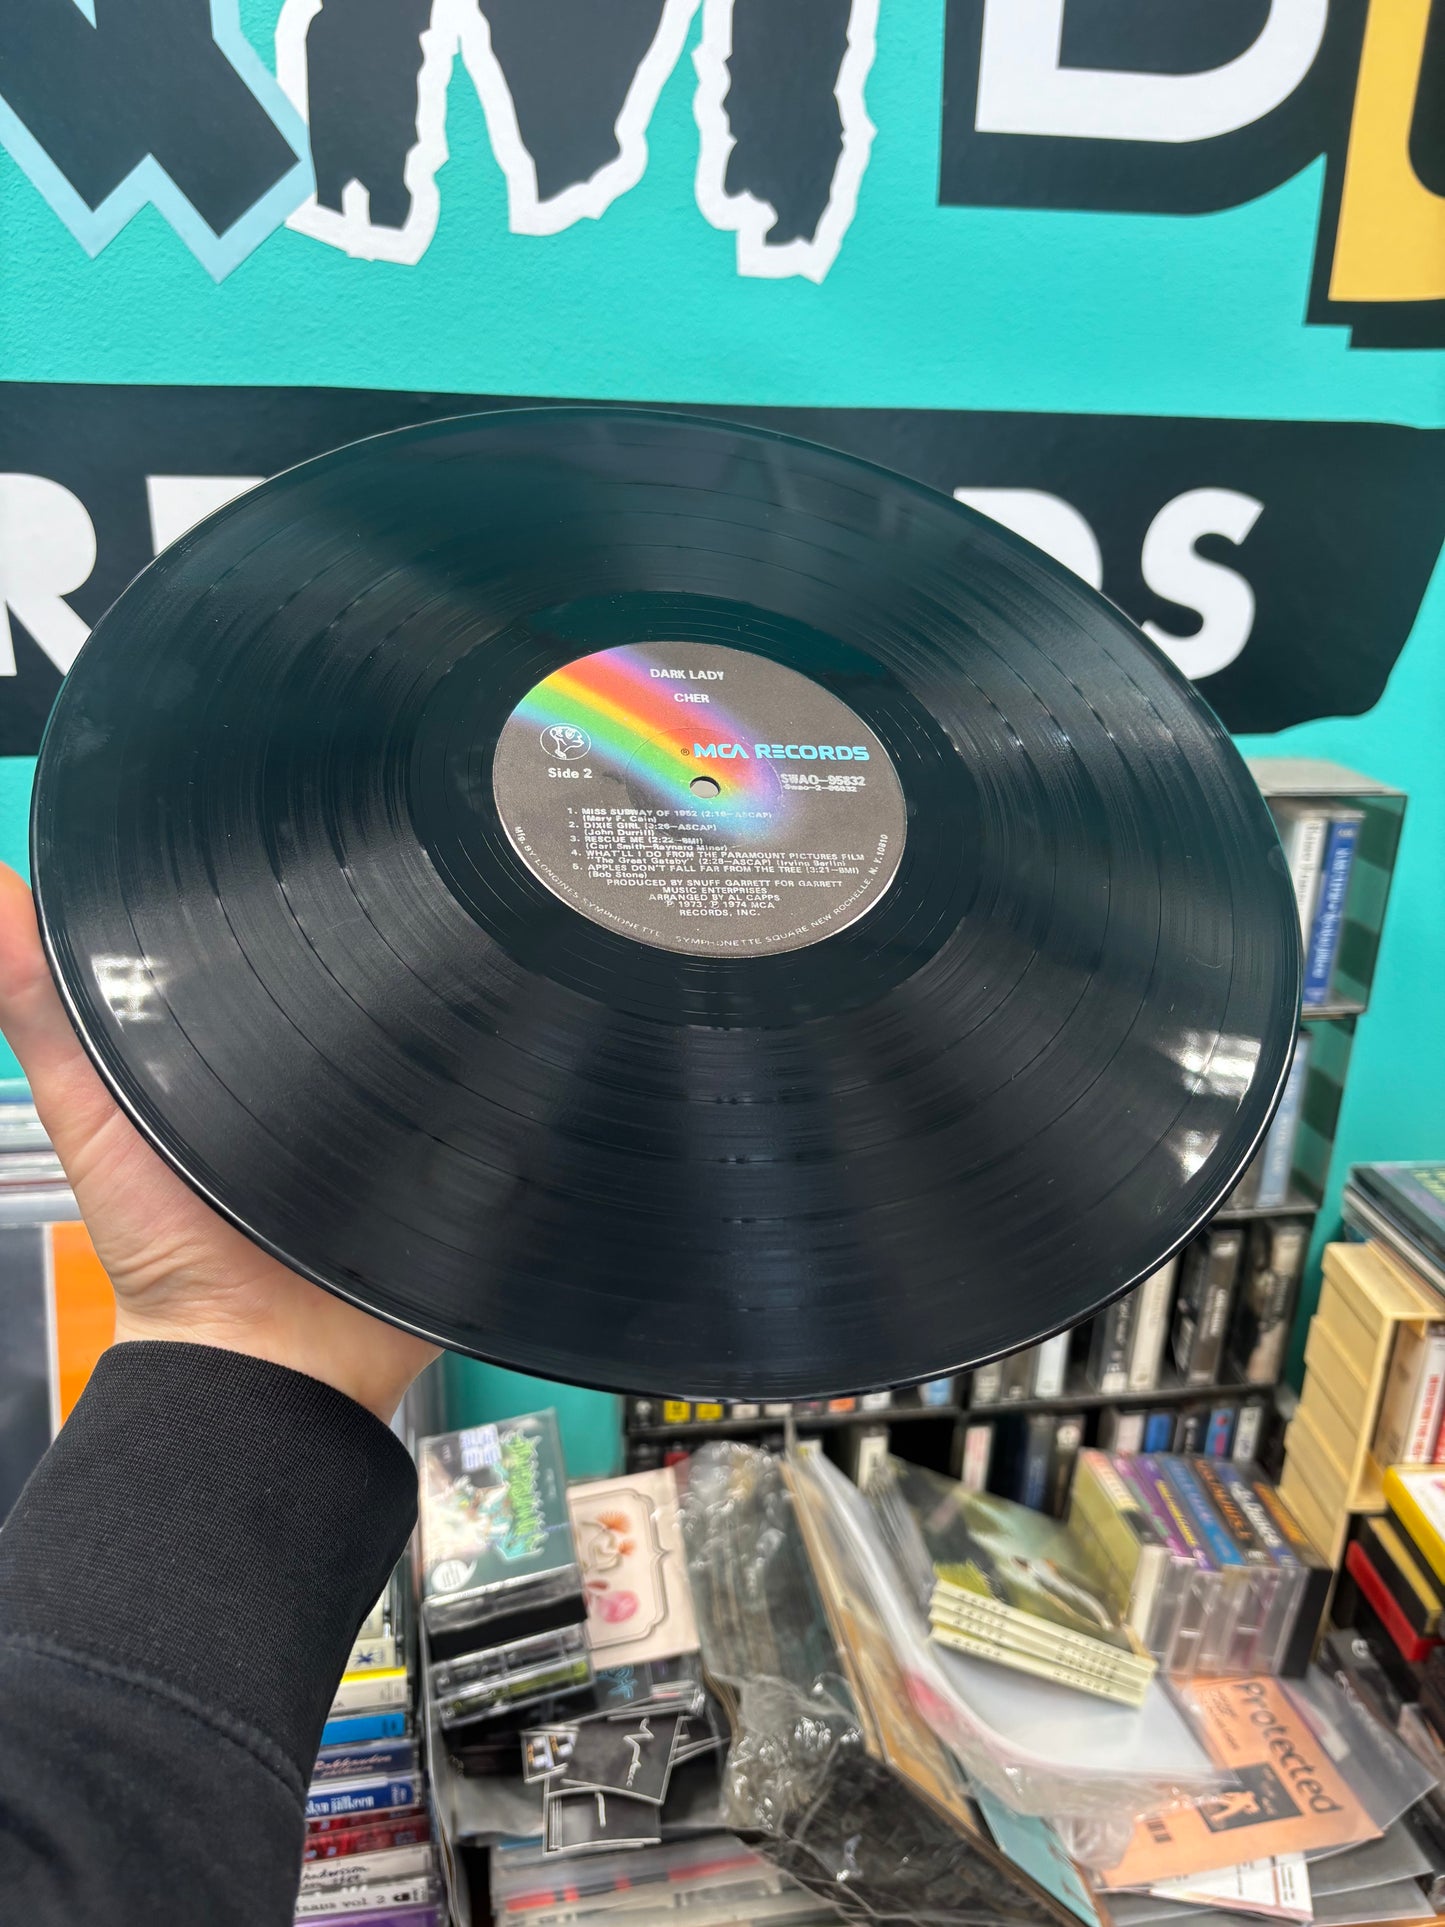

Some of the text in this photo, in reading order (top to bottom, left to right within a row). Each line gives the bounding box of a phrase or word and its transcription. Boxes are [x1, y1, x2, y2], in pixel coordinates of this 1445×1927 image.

[649, 668, 724, 681] DARK LADY
[673, 692, 710, 704] CHER
[693, 743, 870, 761] MCA RECORDS
[548, 767, 593, 779] Side 2
[567, 807, 578, 815] 1.
[581, 808, 607, 816] MISS
[610, 808, 653, 816] SUBWAY
[656, 809, 670, 817] OF
[616, 829, 655, 837] Durrill)
[629, 836, 646, 844] ME
[646, 850, 662, 858] DO
[698, 851, 718, 859] THE
[720, 852, 786, 860] PARAMOUNT
[789, 853, 838, 861] PICTURES
[587, 863, 627, 871] APPLES
[631, 864, 666, 872] DON'T
[779, 866, 801, 874] TREE
[615, 871, 648, 879] Stone)
[514, 826, 526, 845] Mfg.
[524, 845, 537, 857] BY
[534, 858, 579, 899] LONGINES
[765, 925, 810, 941] SQUARE
[810, 913, 833, 929] NEW
[606, 879, 667, 887] PRODUCED
[798, 880, 843, 888] GARRETT
[662, 886, 697, 894] MUSIC
[648, 893, 708, 901] ARRANGED
[1232, 1680, 1345, 1815] Protected
